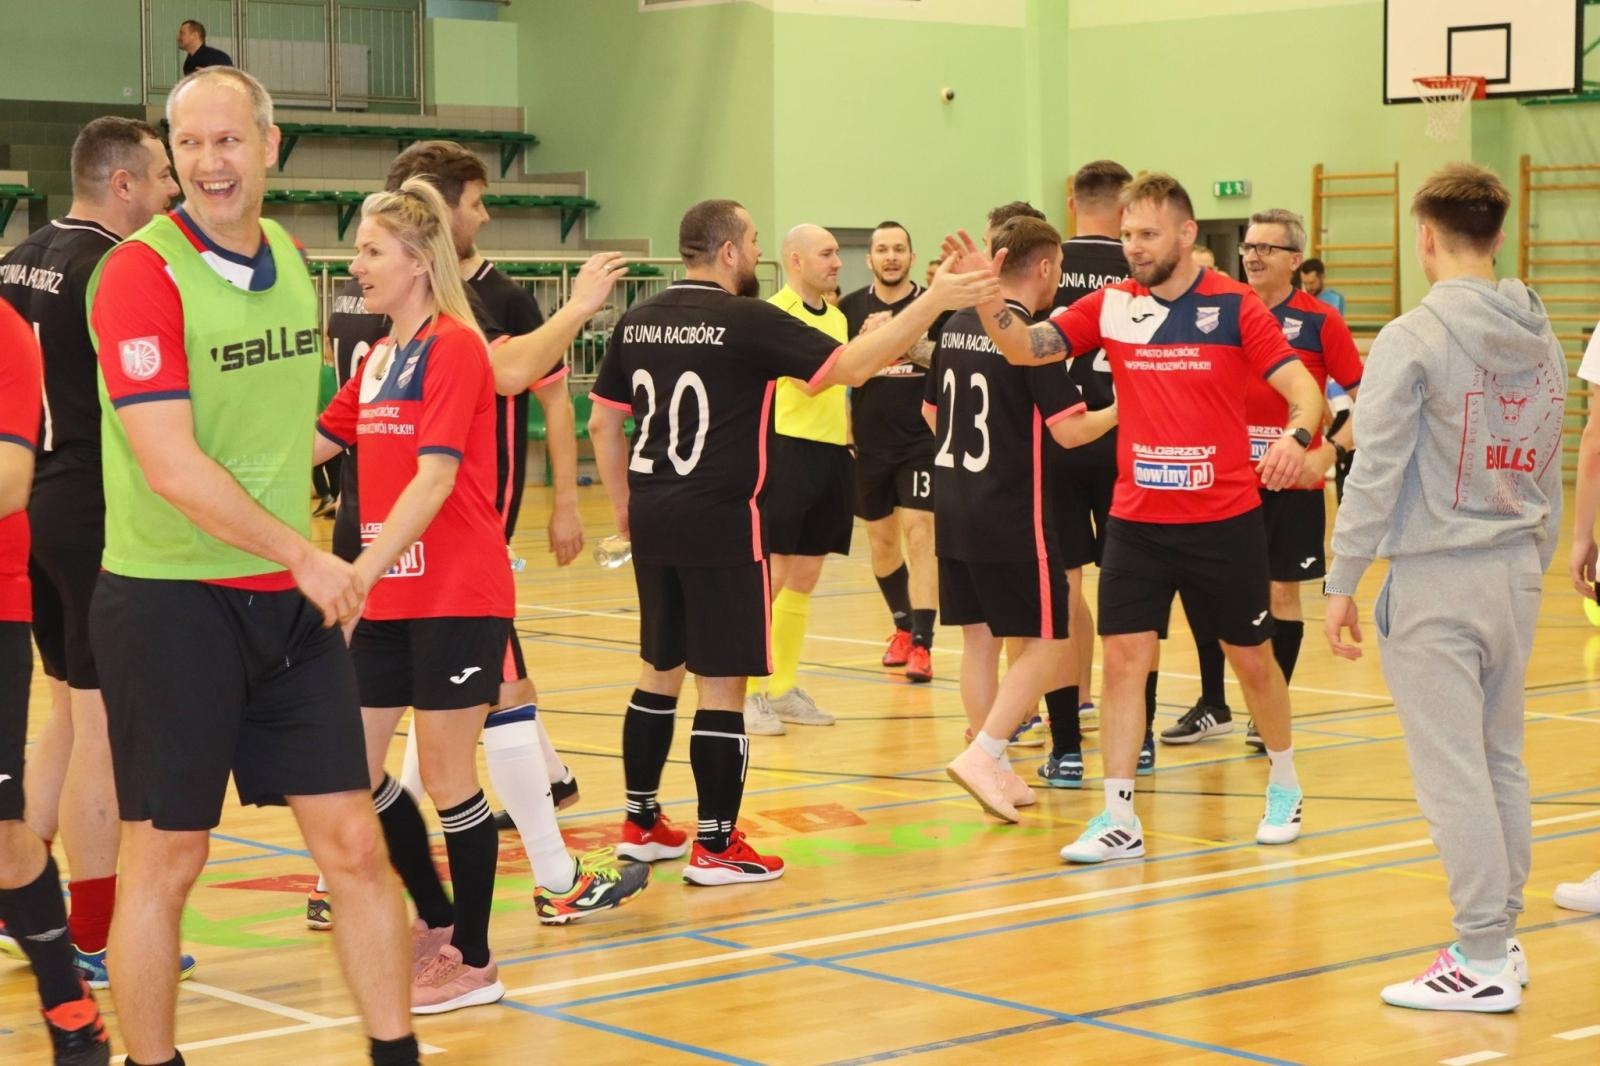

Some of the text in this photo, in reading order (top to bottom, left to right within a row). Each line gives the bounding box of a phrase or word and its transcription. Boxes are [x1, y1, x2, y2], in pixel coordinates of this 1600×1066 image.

[1058, 272, 1086, 289] UNIA
[623, 321, 726, 345] KS UNIA RACIBÓRZ
[629, 368, 710, 476] 20
[934, 368, 990, 473] 23
[1486, 444, 1536, 473] BULLS
[913, 470, 930, 498] 13
[1135, 463, 1209, 488] nowiny.pl
